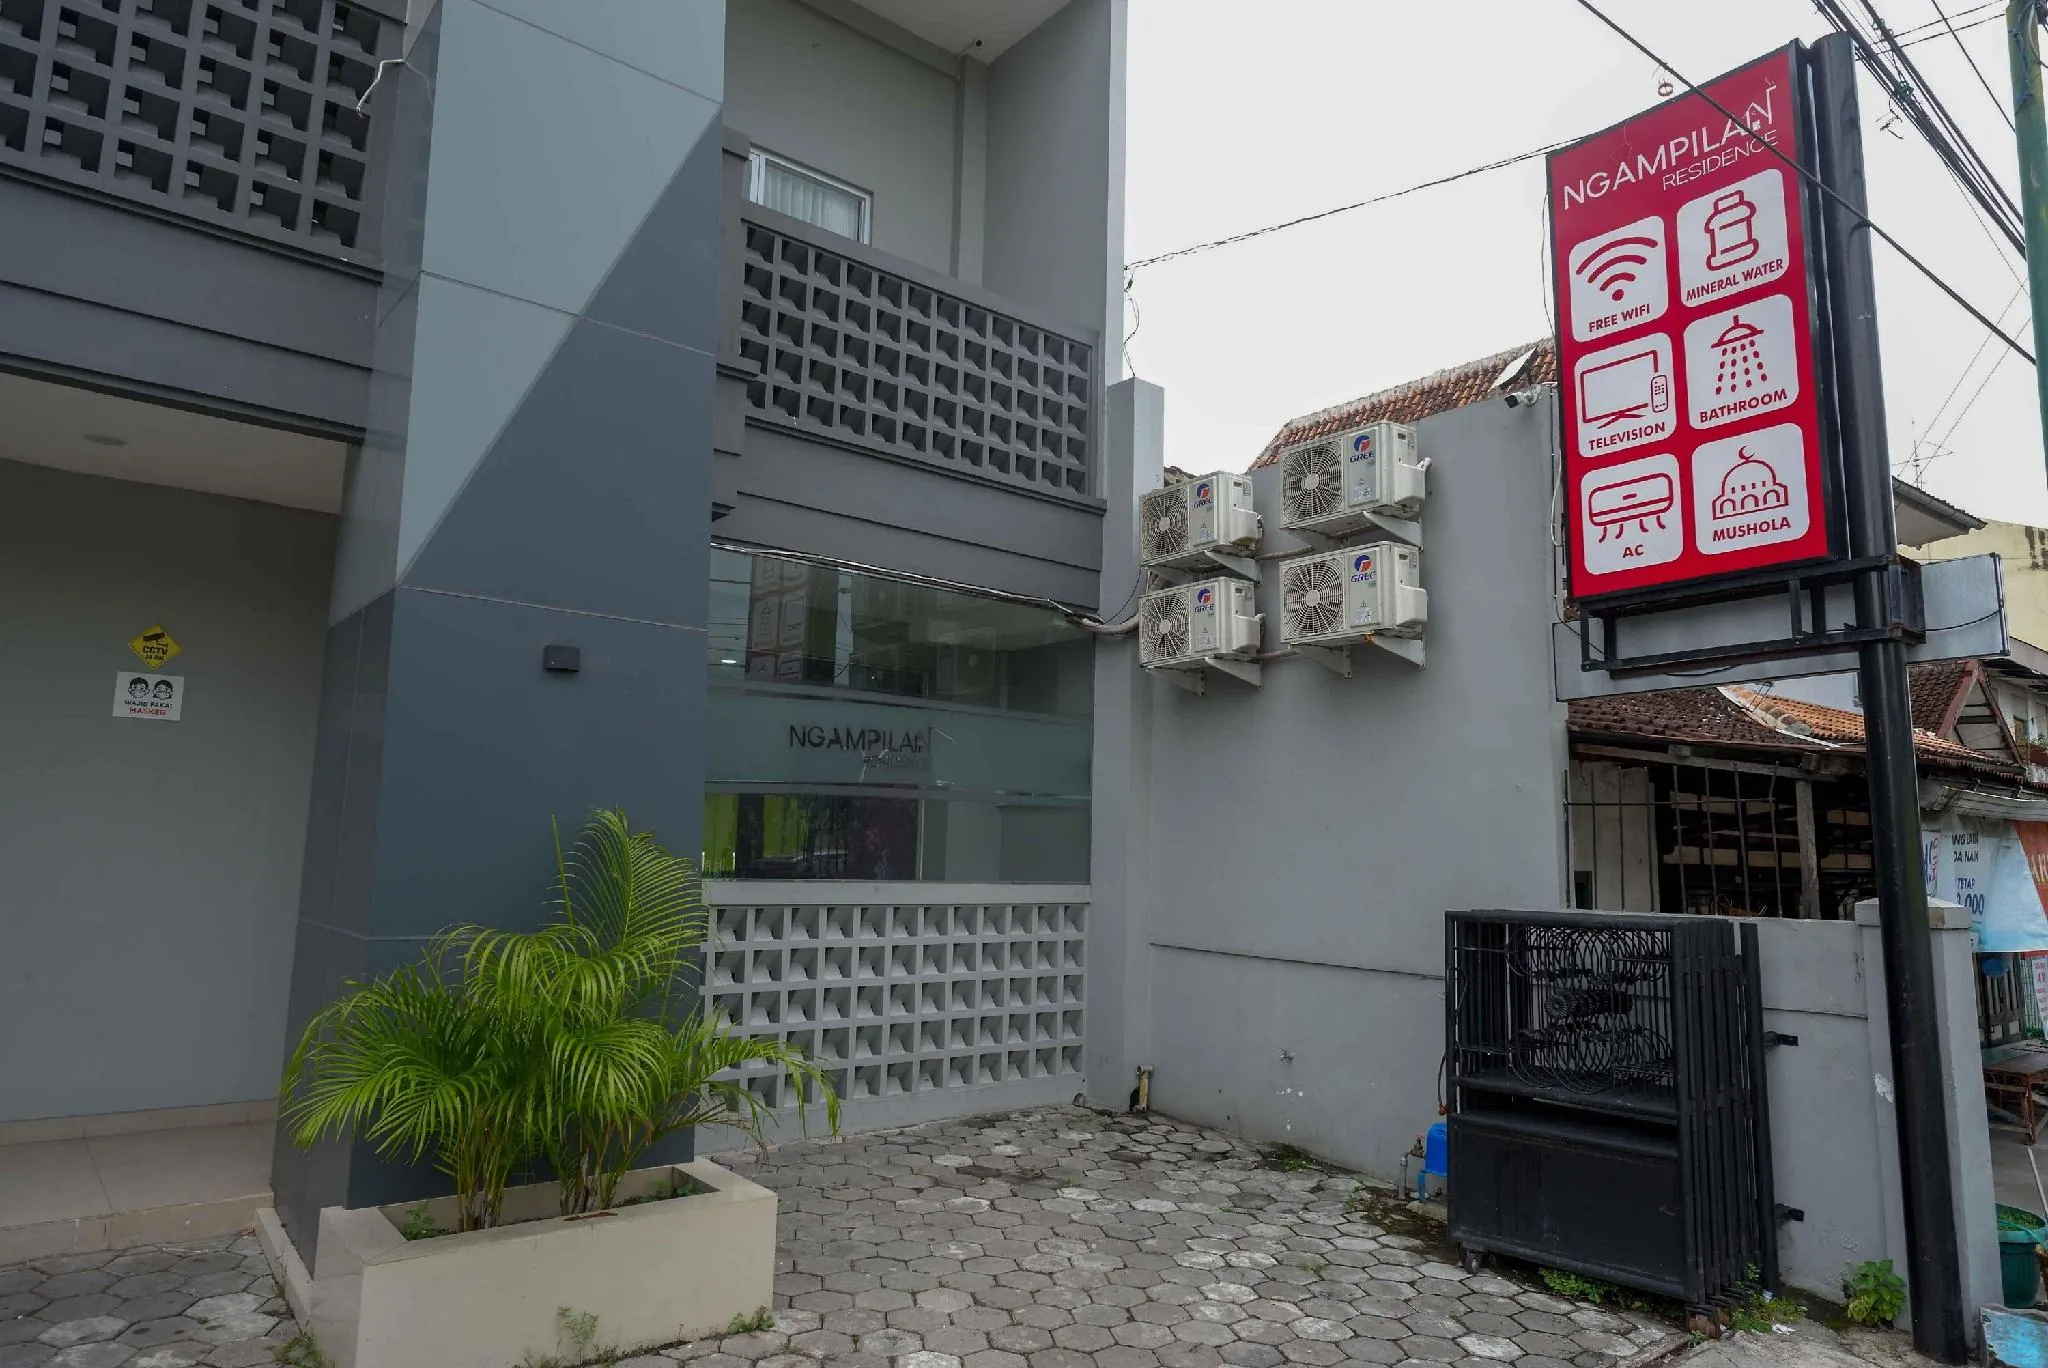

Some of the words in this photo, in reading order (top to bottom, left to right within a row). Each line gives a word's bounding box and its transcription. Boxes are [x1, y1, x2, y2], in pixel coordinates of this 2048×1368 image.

[1564, 84, 1777, 211] NGAMPILAN
[1662, 129, 1778, 191] RESIDENCE
[1686, 274, 1739, 302] MINERAL
[1741, 259, 1784, 283] WATER
[1588, 314, 1618, 333] FREE
[1621, 304, 1650, 322] WIFI
[1700, 388, 1788, 423] BATHROOM
[1588, 421, 1666, 451] TELEVISION
[1712, 516, 1792, 542] MUSHOLA
[1622, 544, 1644, 559] AC
[143, 645, 168, 656] CCTV
[124, 699, 148, 708] WAJIB
[130, 708, 166, 716] MASKER
[789, 724, 932, 754] NGAMPILAN
